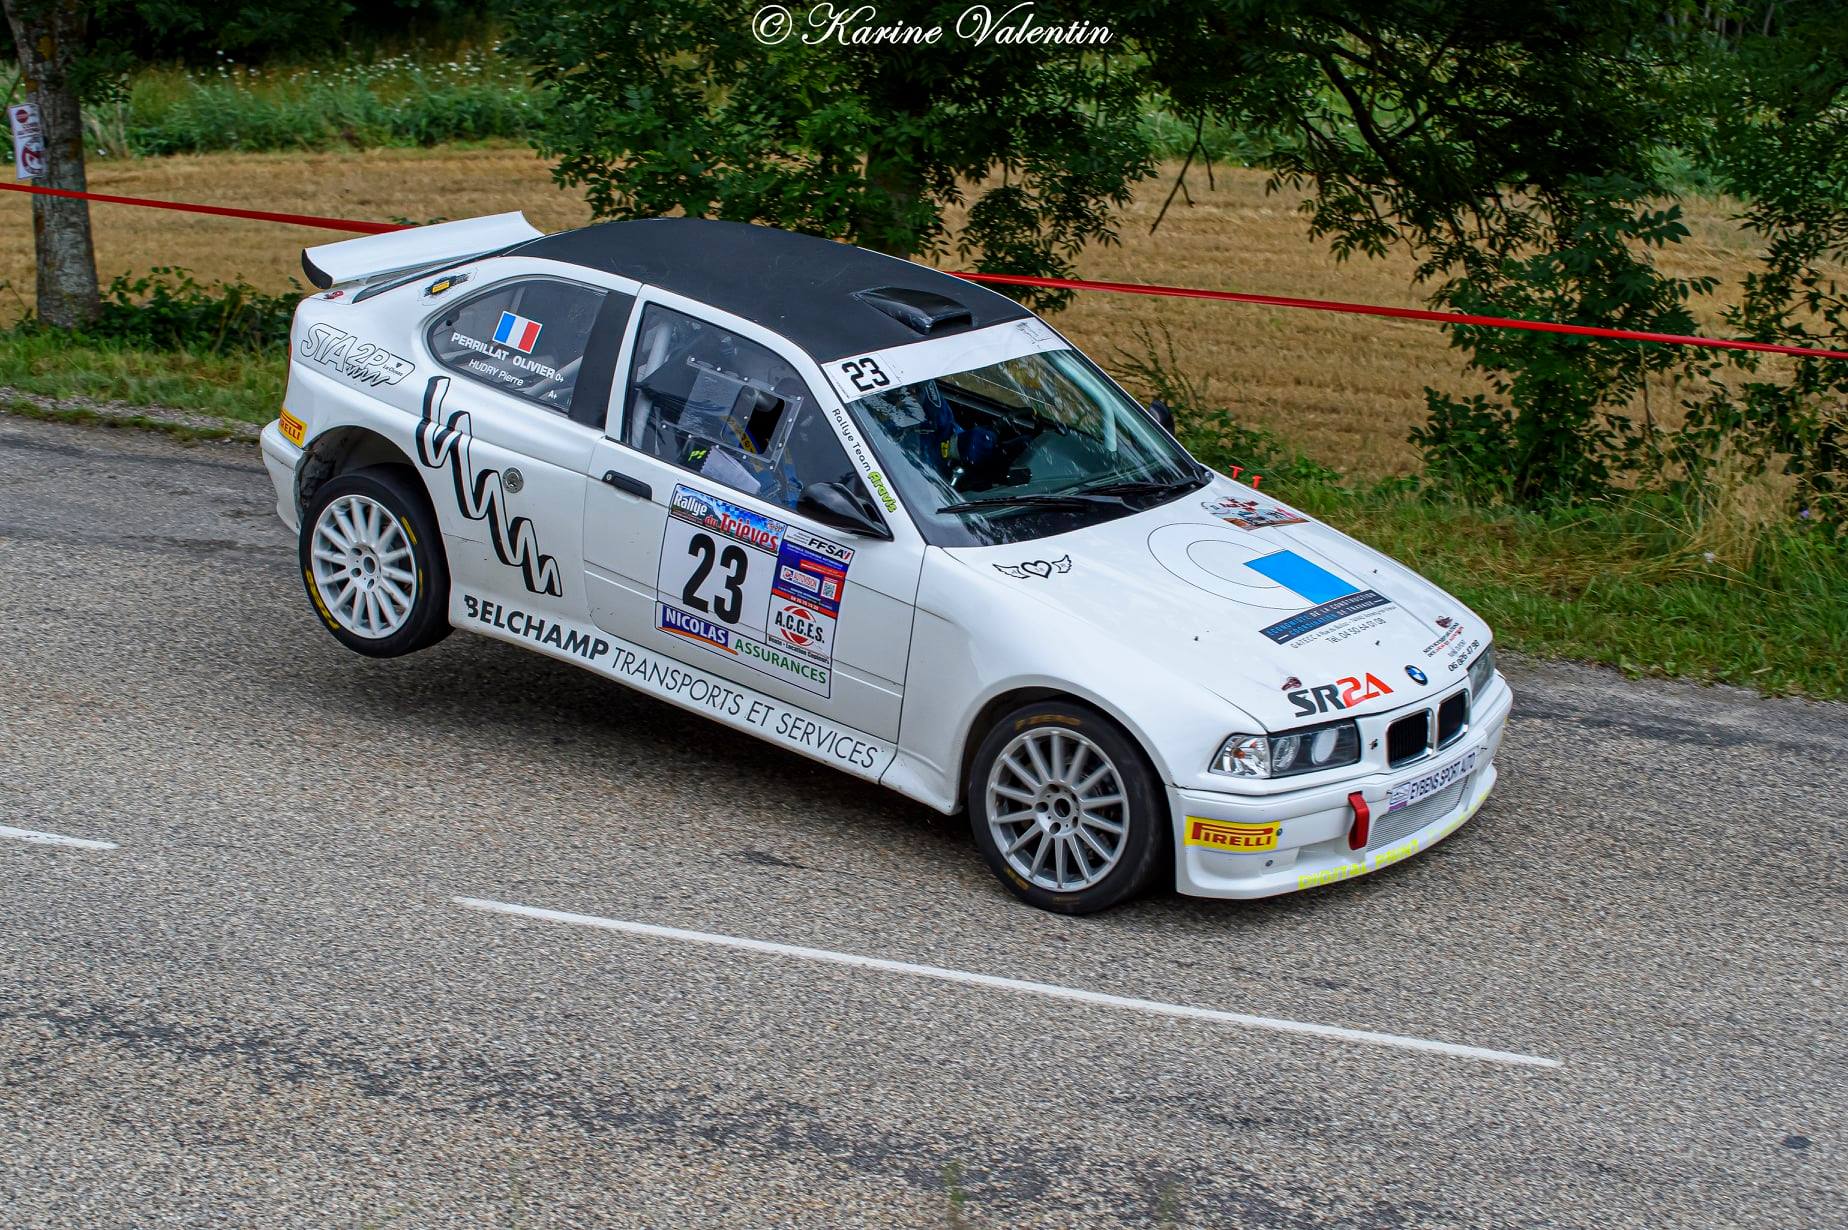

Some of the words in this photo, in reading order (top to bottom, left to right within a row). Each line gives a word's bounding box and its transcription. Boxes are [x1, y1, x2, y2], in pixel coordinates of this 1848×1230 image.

[451, 332, 509, 361] PERRILLAT
[512, 355, 556, 380] OLIVIER
[468, 359, 498, 376] HUDRY
[498, 370, 524, 386] Pierre
[841, 357, 890, 393] 23
[832, 408, 854, 442] Rallye
[852, 441, 871, 473] Team
[867, 471, 897, 514] Aravis
[673, 492, 708, 516] Rallye
[808, 538, 844, 559] FFSA
[682, 533, 748, 624] 23
[774, 611, 825, 643] A.C.C.E.S.
[1310, 610, 1320, 618] DE
[666, 607, 727, 644] NICOLAS
[735, 638, 826, 685] ASSURANCES
[464, 594, 609, 660] BELCHAMP
[612, 647, 744, 716] TRANSPORTS
[746, 700, 775, 726] ET
[776, 713, 878, 768] SERVICES
[1410, 772, 1440, 800] EYBENS
[1439, 760, 1461, 787] SPORT
[1192, 822, 1274, 846] PIRELLI
[1298, 860, 1367, 890] DIGITAL
